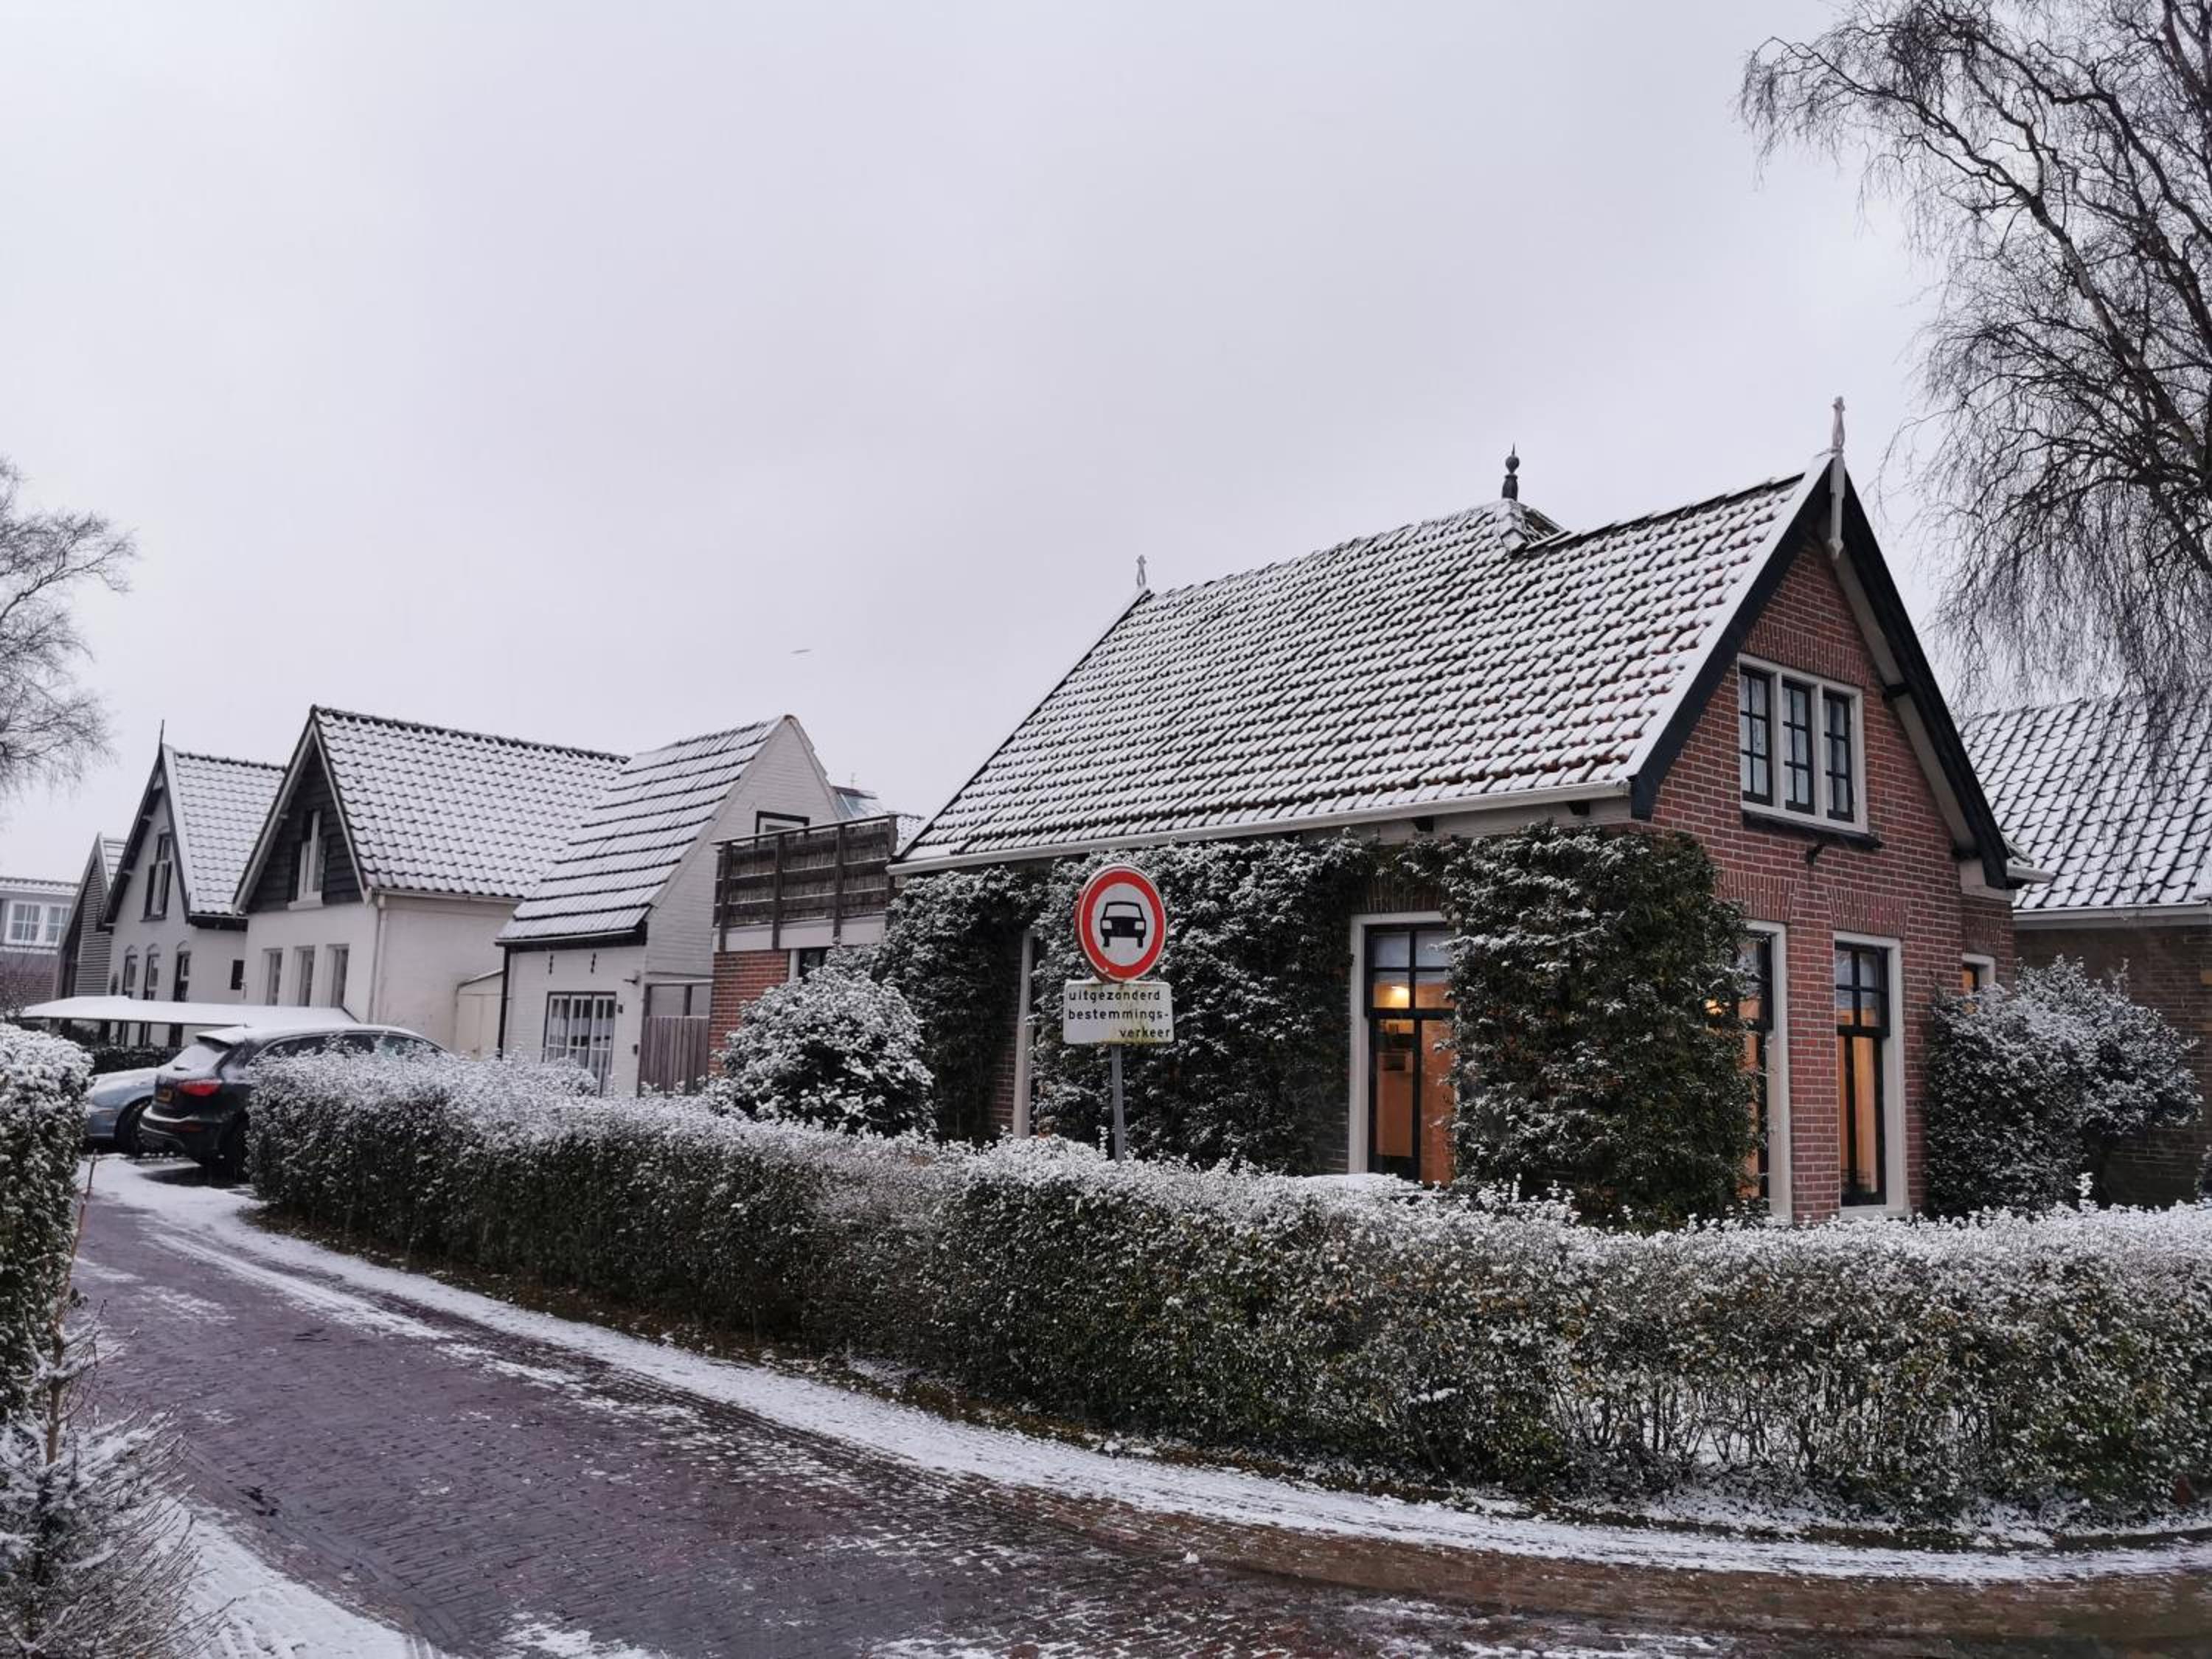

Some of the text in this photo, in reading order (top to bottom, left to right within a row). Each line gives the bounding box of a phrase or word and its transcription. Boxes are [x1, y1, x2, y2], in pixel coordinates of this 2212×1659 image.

[1068, 990, 1160, 1004] uitgezonderd
[1068, 1008, 1169, 1022] bestemmings-
[1119, 1026, 1171, 1038] verkeer
